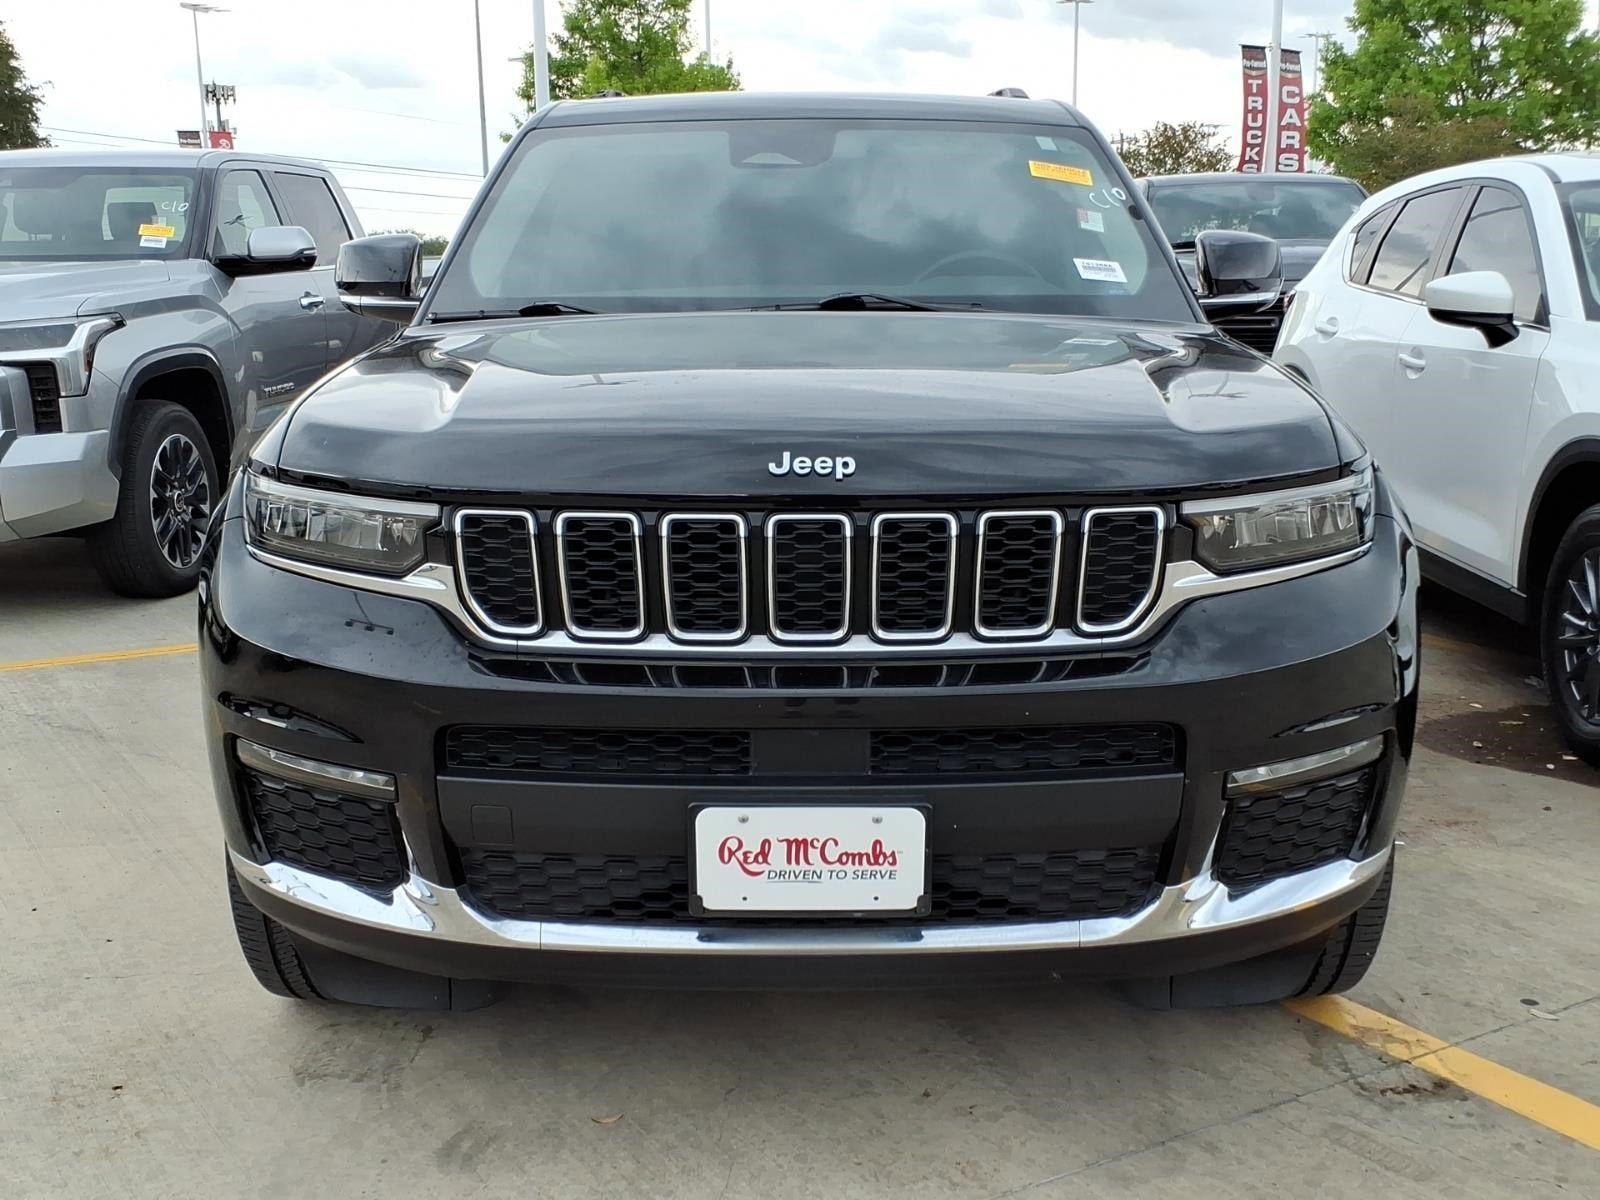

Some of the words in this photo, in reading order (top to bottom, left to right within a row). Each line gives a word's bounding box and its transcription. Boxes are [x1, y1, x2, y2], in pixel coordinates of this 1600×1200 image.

[1278, 85, 1302, 171] CARS
[768, 451, 856, 480] Jeep
[718, 835, 772, 877] Red
[776, 836, 898, 867] McCombs
[766, 869, 823, 880] DRIVEN
[827, 869, 848, 880] TO
[852, 869, 897, 880] SERVE
